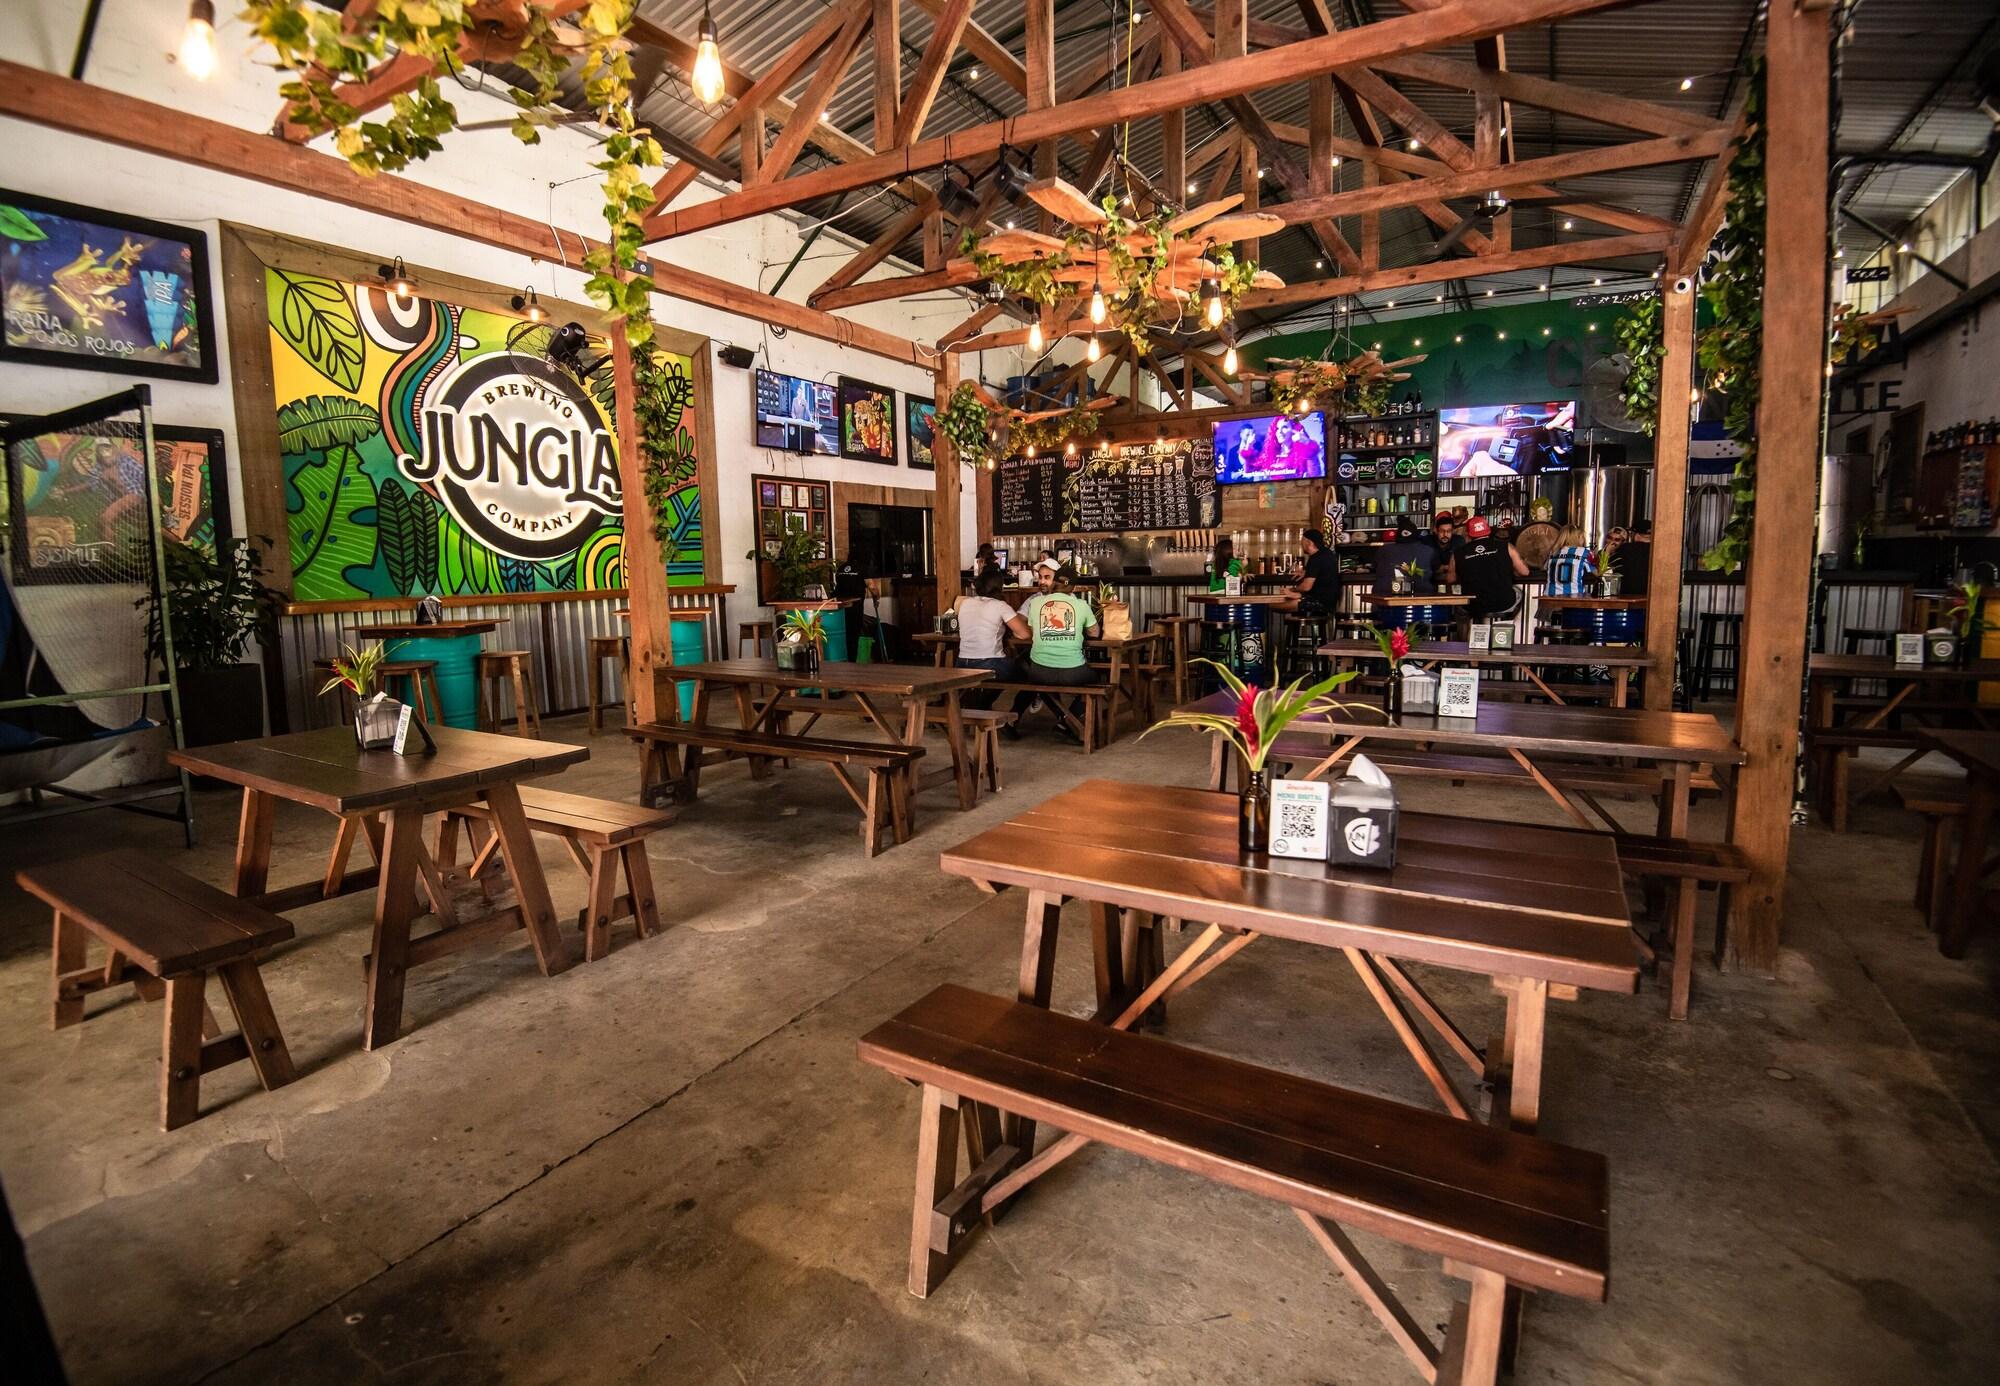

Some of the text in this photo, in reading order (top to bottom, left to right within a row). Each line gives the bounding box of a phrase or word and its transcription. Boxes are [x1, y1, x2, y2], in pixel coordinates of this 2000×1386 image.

[155, 281, 173, 305] IPA
[9, 310, 62, 334] RANA
[34, 329, 136, 355] OJOS ROJOS
[481, 382, 574, 420] BREWING
[400, 410, 623, 515] JUNGLA
[1089, 449, 1113, 460] JUNGLA
[1120, 445, 1146, 457] BREWING
[1148, 442, 1177, 455] COMPANY
[178, 463, 196, 521] SESSION IPA
[486, 503, 574, 533] COMPANY
[1104, 506, 1115, 514] IPA
